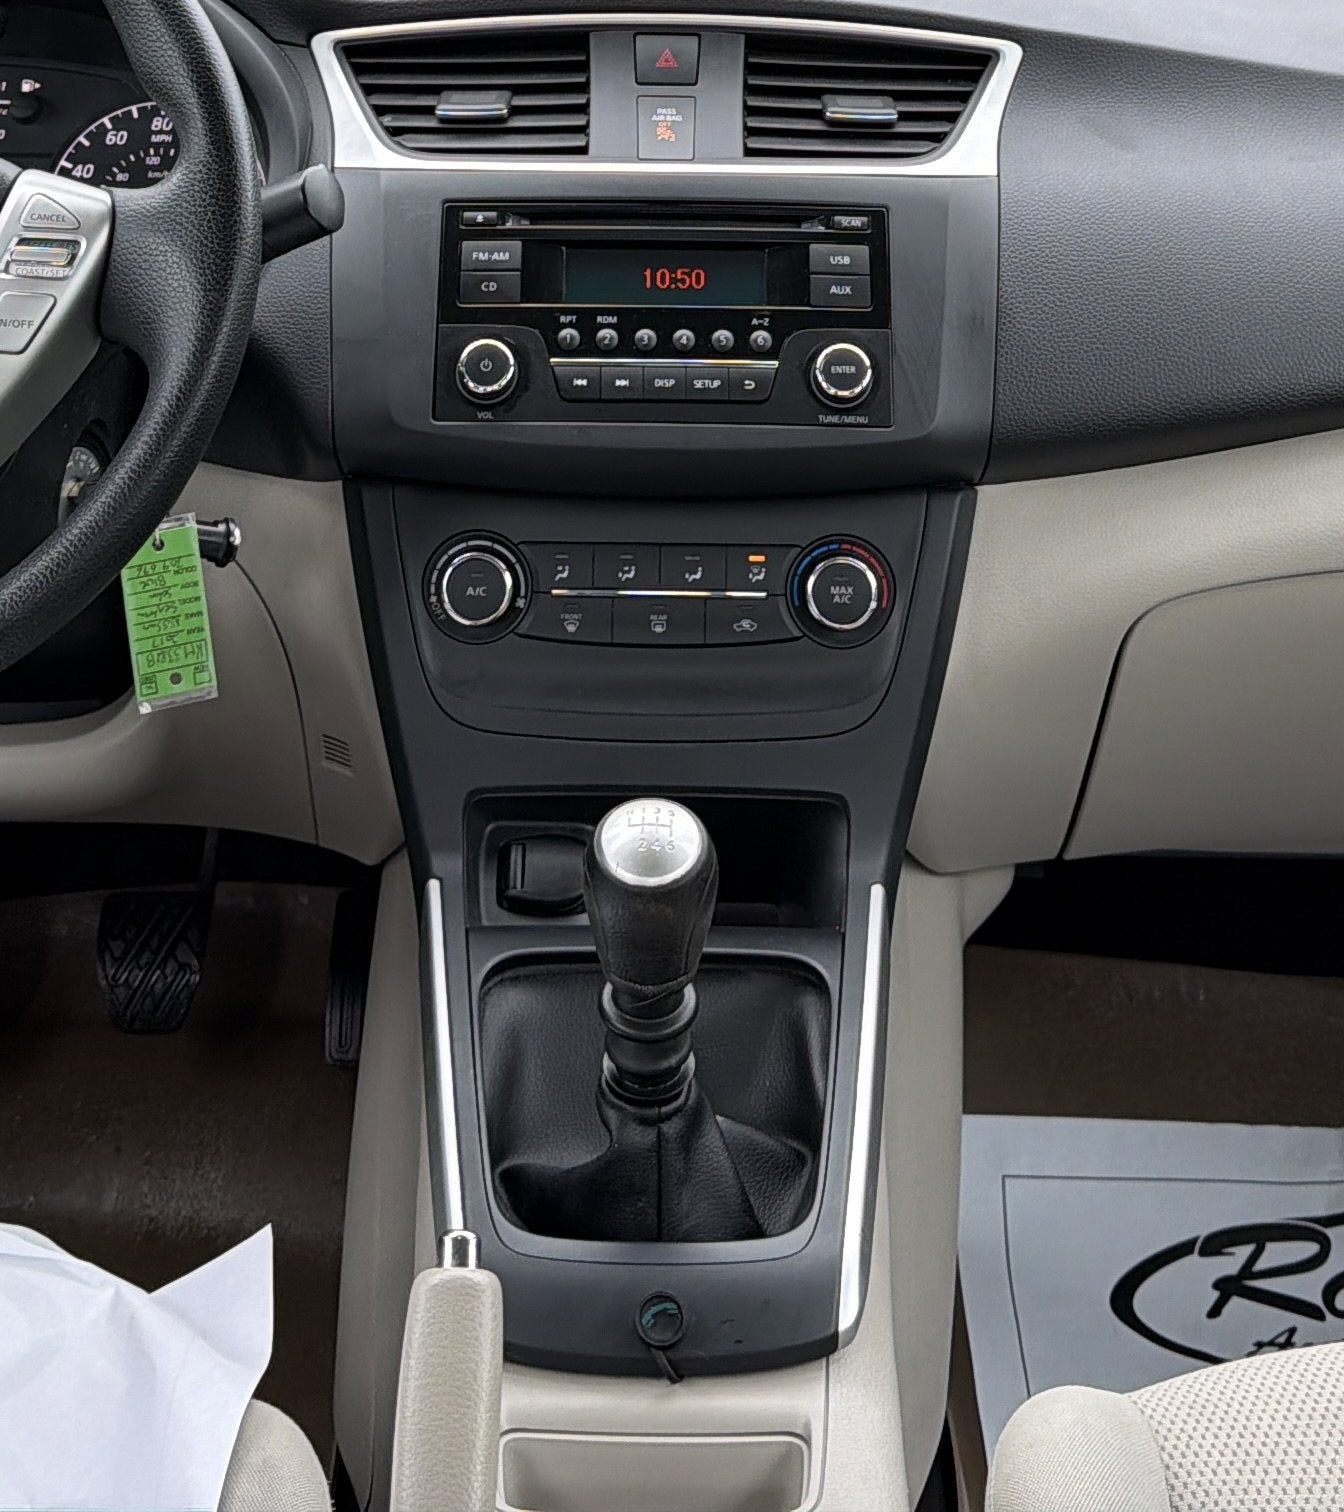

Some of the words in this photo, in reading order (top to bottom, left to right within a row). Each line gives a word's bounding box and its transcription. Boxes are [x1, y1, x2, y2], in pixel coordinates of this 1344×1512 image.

[151, 116, 173, 131] 80
[105, 130, 128, 145] 60
[150, 134, 173, 143] MPH
[145, 156, 161, 165] 120
[71, 163, 95, 179] 40
[116, 172, 130, 182] 80
[30, 212, 67, 223] CANCEL
[840, 218, 862, 228] SCAN
[829, 255, 851, 265] USB
[15, 267, 67, 277] COAST/SET
[643, 267, 707, 290] 10:50
[480, 281, 498, 292] CD
[829, 284, 852, 295] AUX
[559, 315, 577, 324] RPT
[596, 315, 618, 324] RDM
[603, 334, 611, 343] 2
[642, 334, 649, 344] 3
[680, 335, 688, 345] 4
[719, 335, 727, 345] 5
[757, 335, 765, 345] 6
[830, 365, 857, 374] ENTER
[654, 378, 676, 388] DISP
[693, 379, 722, 389] SETUP
[476, 411, 495, 420] VOL
[818, 414, 869, 424] TUNE/MENU
[465, 586, 488, 597] A/C
[830, 585, 855, 595] MAX
[832, 594, 853, 604] A/C
